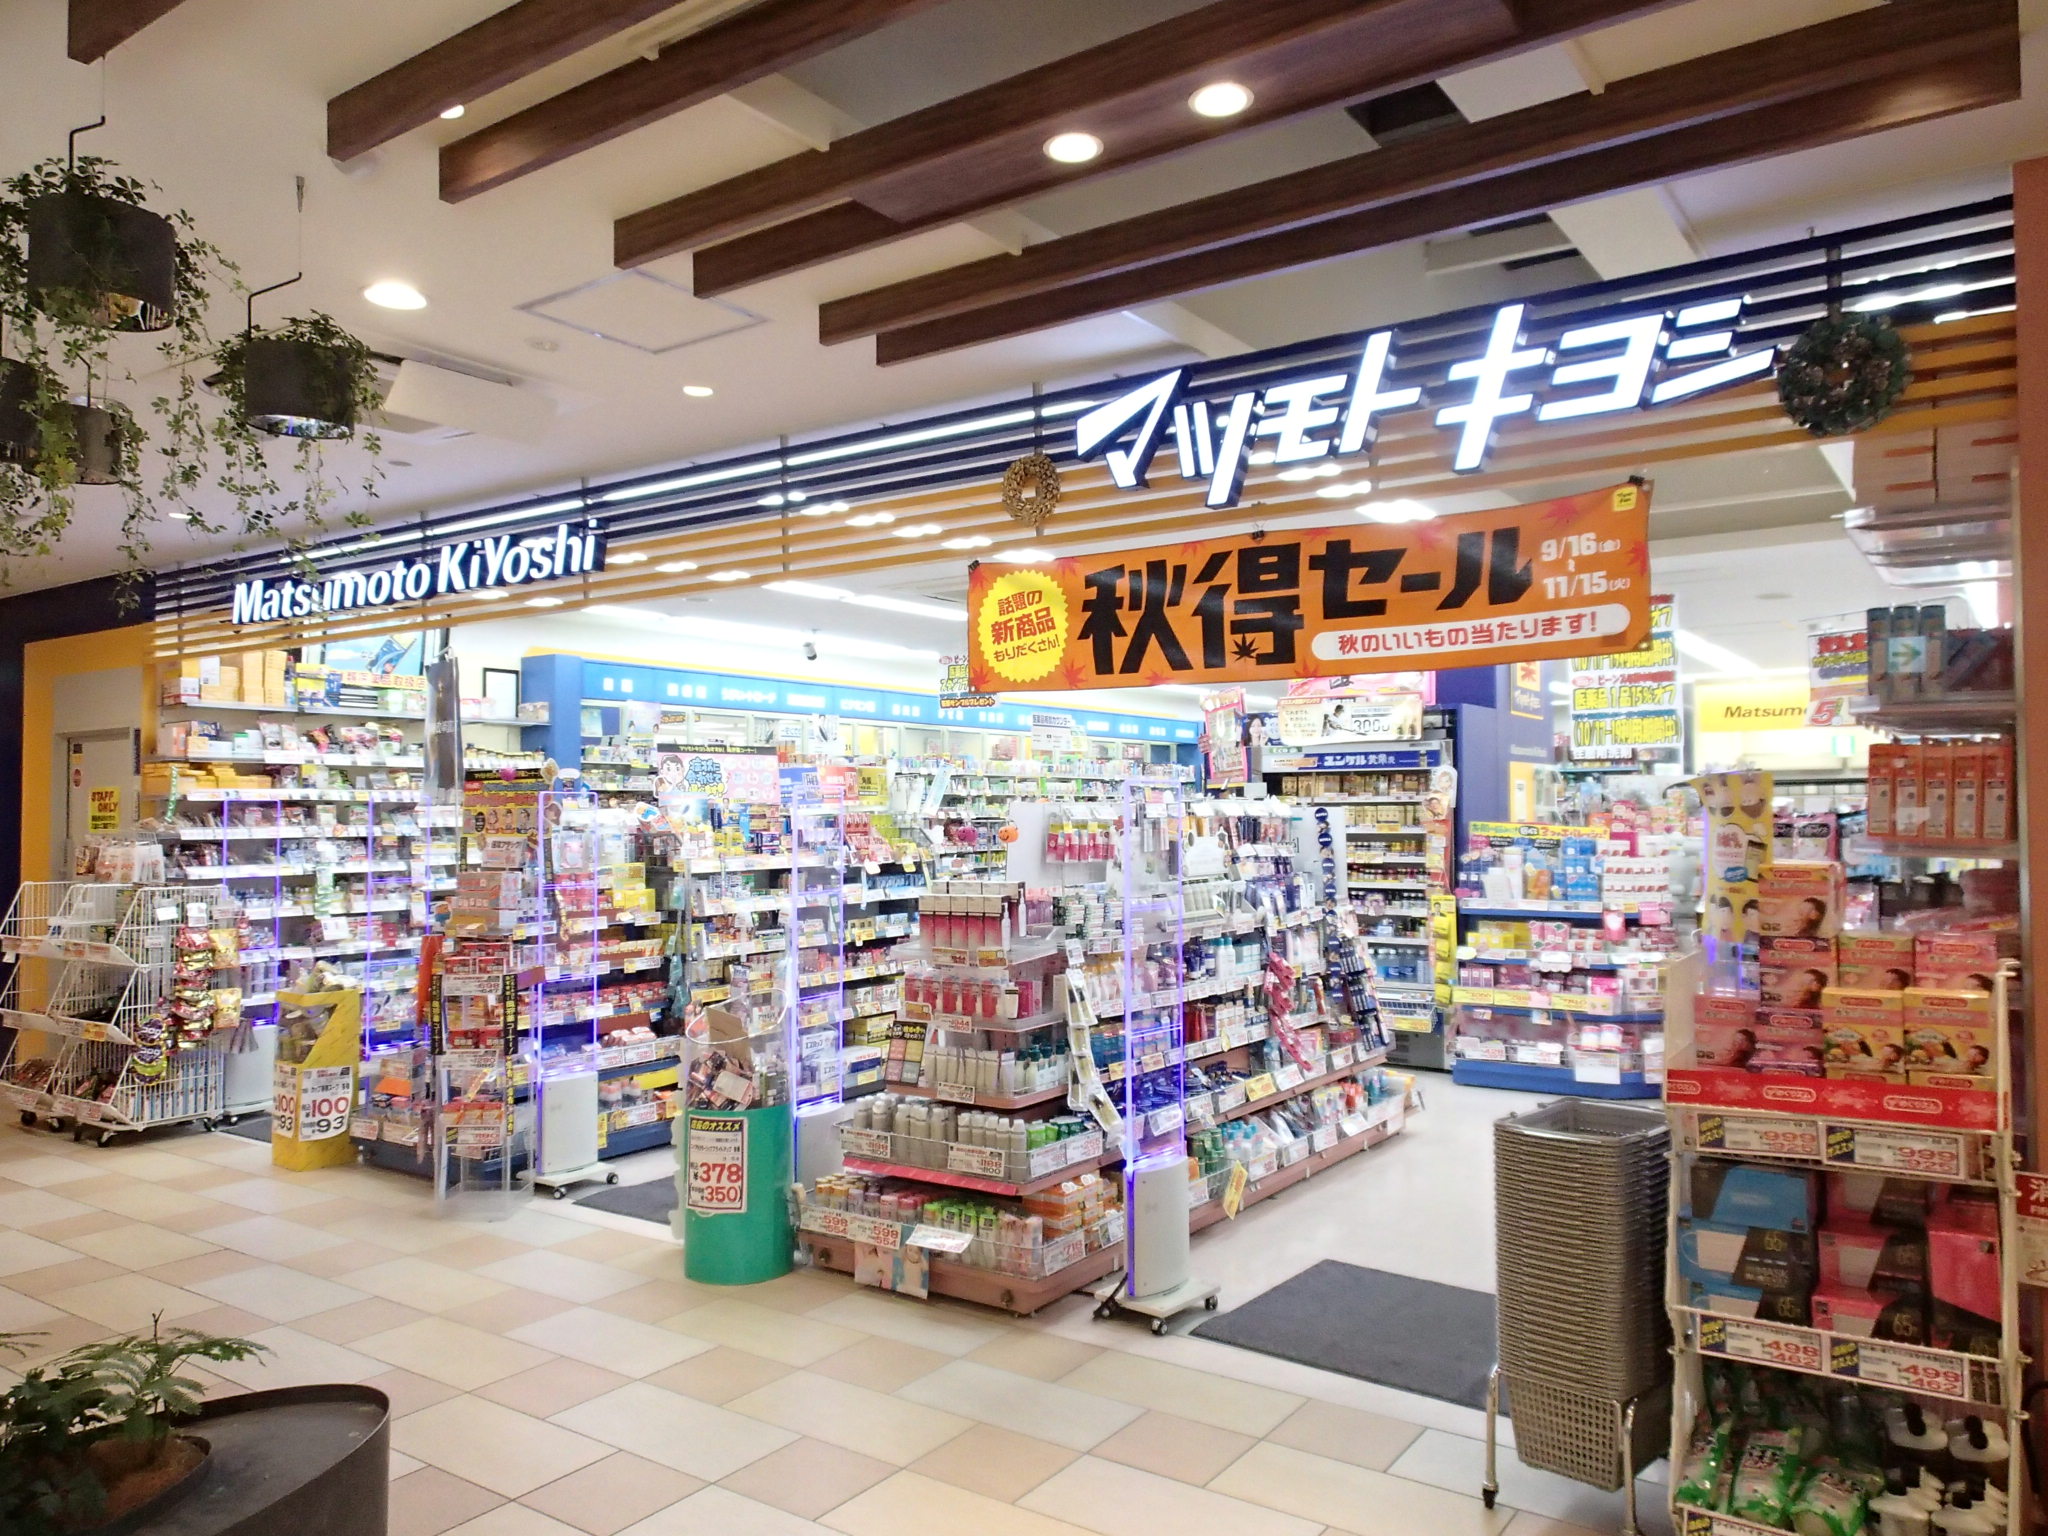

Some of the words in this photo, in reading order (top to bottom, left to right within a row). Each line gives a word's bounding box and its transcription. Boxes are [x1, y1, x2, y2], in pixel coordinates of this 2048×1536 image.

[1076, 299, 1774, 505] マツモトキヨシ
[232, 560, 431, 624] Matsumoto
[437, 518, 598, 593] KiYoshi
[998, 590, 1042, 616] 話題の
[1077, 526, 1534, 675] 秋得セール
[991, 606, 1056, 645] 新商品
[1338, 611, 1597, 655] 秋のいいもの当たります!
[994, 634, 1060, 662] もりだくさん!
[1723, 704, 1807, 719] Matsum
[91, 791, 115, 802] STAFF
[97, 802, 118, 812] ONLY
[312, 1096, 349, 1118] 100
[280, 1115, 293, 1131] 93
[316, 1115, 345, 1133] 93
[699, 1161, 743, 1184] 378
[823, 1215, 848, 1226] 598
[873, 1225, 899, 1239] 598
